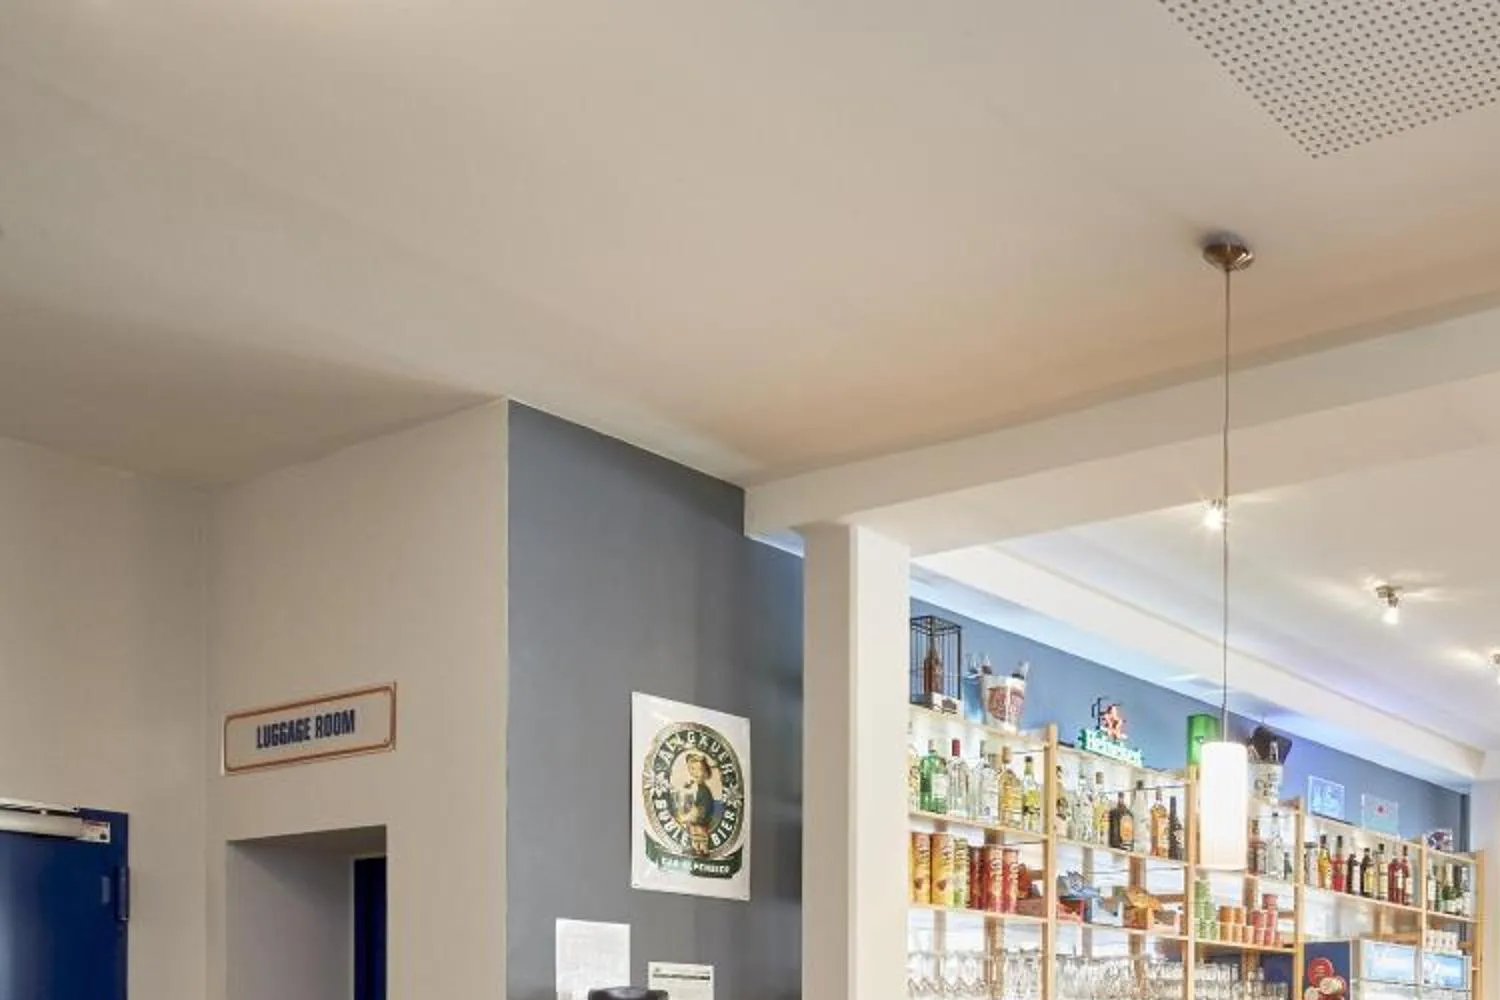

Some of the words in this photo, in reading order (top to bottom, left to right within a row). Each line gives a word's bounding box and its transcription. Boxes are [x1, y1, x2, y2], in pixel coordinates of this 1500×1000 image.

[256, 717, 311, 748] LUGGAGE
[315, 709, 355, 738] ROOM
[711, 810, 735, 847] BIER
